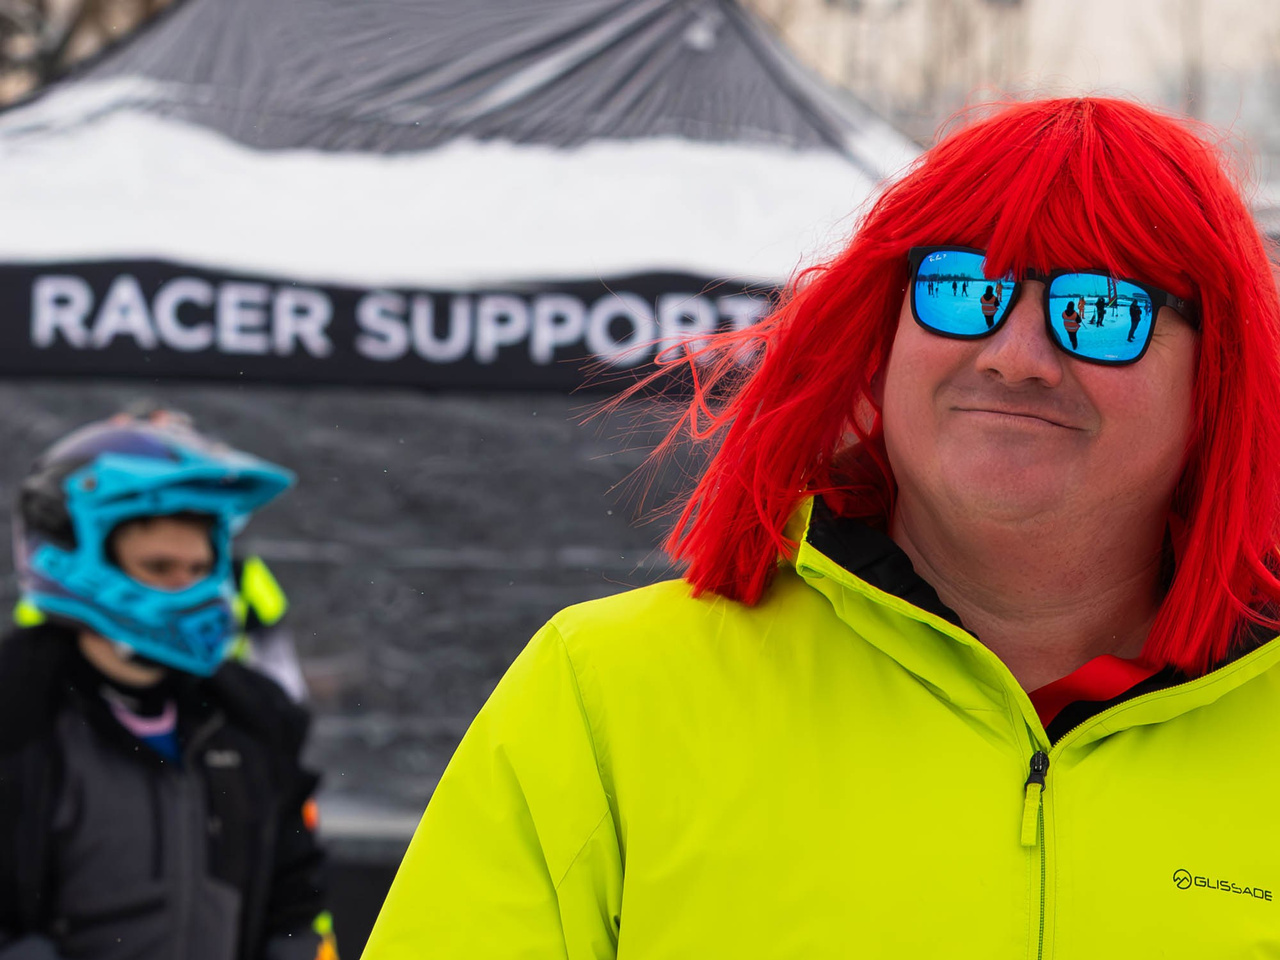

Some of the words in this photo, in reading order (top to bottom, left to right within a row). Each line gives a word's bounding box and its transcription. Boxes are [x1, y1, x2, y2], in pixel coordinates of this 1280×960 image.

[31, 274, 334, 357] RACER
[356, 290, 774, 366] SUPPORT
[1194, 876, 1272, 901] GLISSADE
